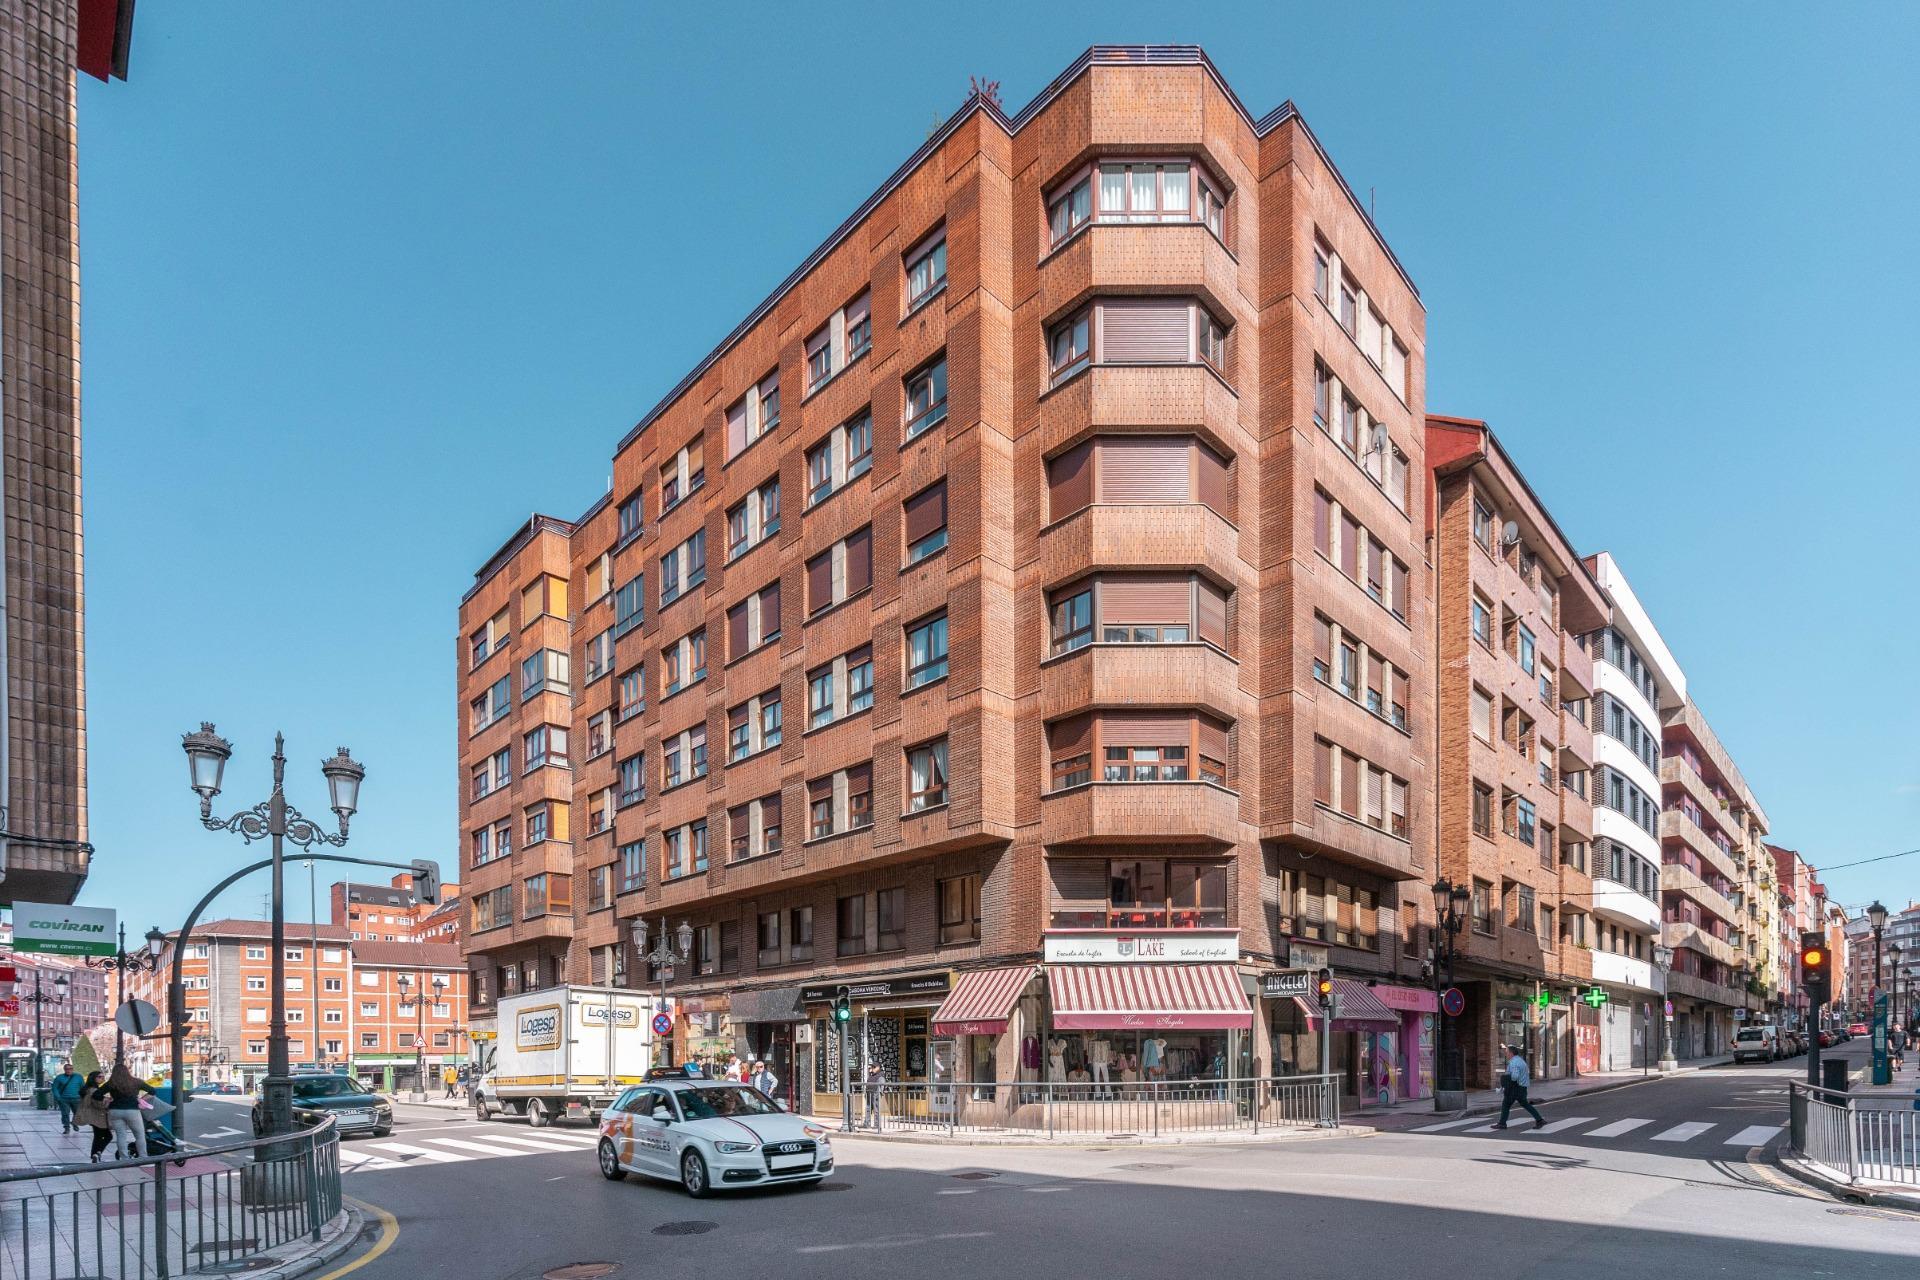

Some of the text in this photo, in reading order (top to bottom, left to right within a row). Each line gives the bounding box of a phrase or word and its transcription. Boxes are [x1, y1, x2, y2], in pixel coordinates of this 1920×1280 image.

[1138, 937, 1165, 956] LAKE
[1180, 948, 1227, 957] School of English
[1266, 974, 1308, 991] ANGELES
[588, 1006, 632, 1020] Logesp
[520, 1016, 556, 1036] Logesp
[799, 1030, 804, 1039] 3
